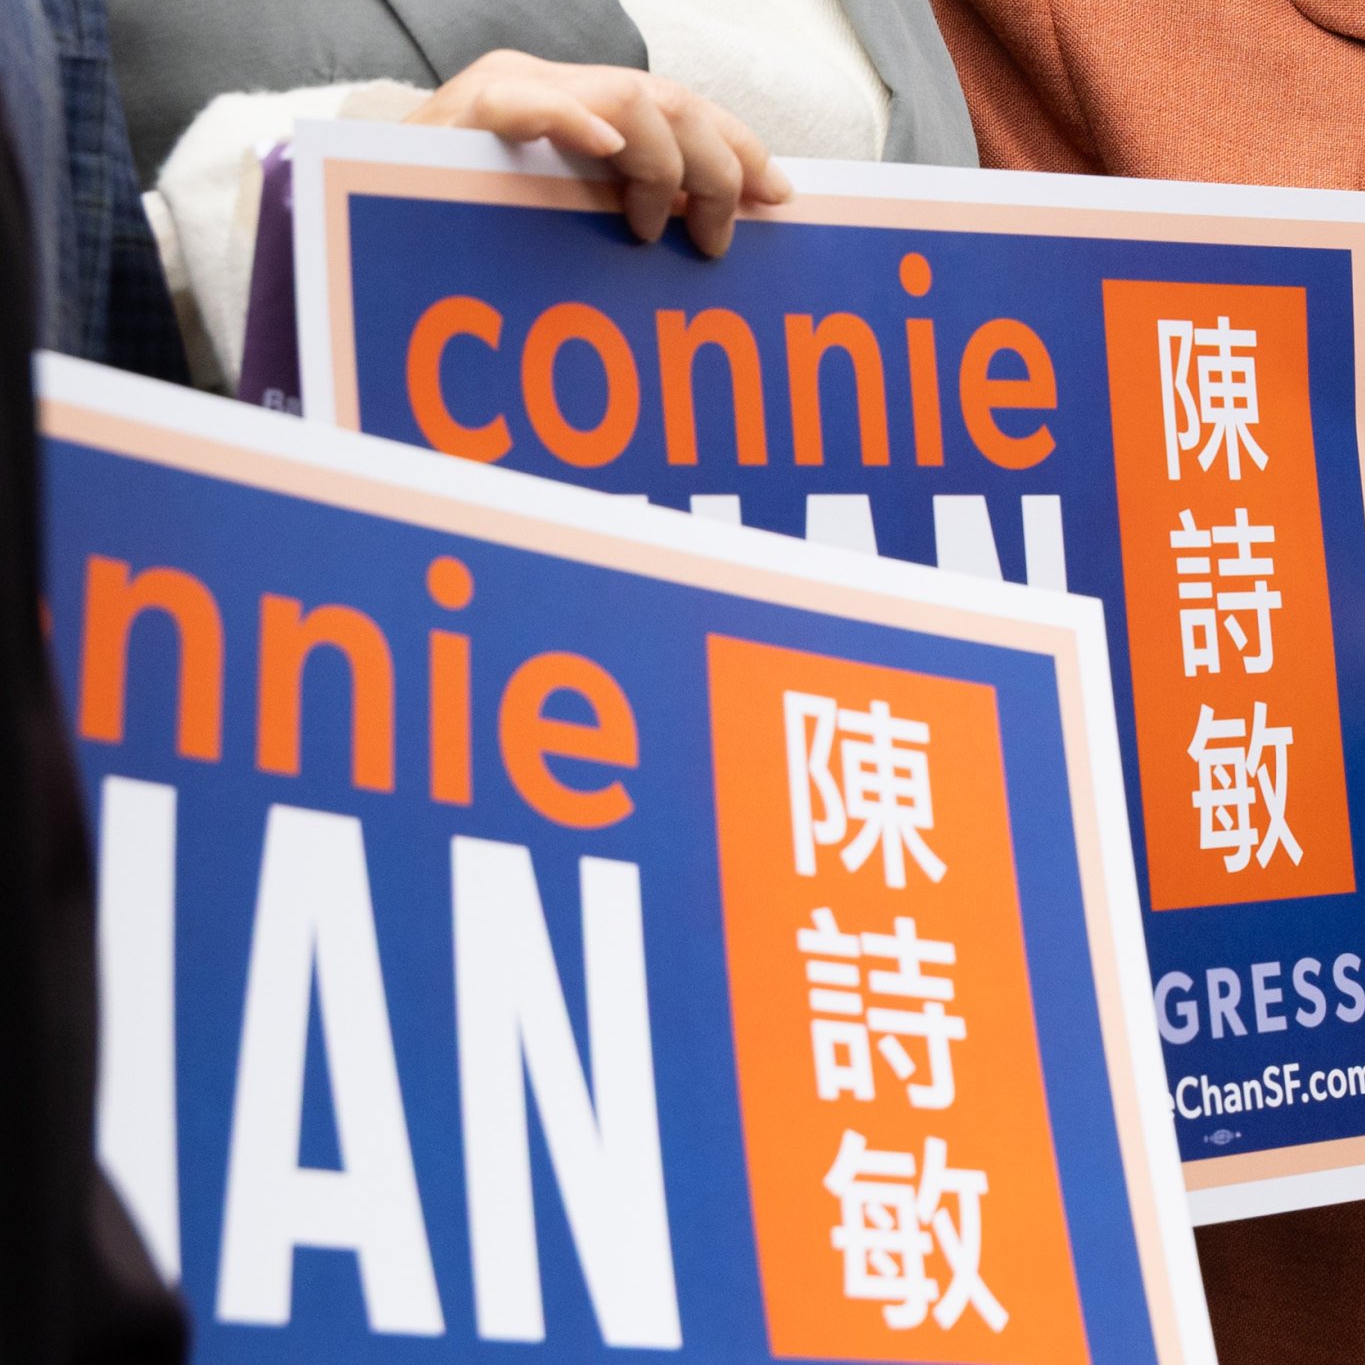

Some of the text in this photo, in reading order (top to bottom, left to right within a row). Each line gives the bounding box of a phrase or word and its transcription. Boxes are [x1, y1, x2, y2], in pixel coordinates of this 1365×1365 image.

[407, 253, 1058, 469] connie
[79, 558, 638, 829] nnie
[1156, 315, 1305, 874] 陳詩敏
[782, 689, 1010, 1334] 陳詩敏
